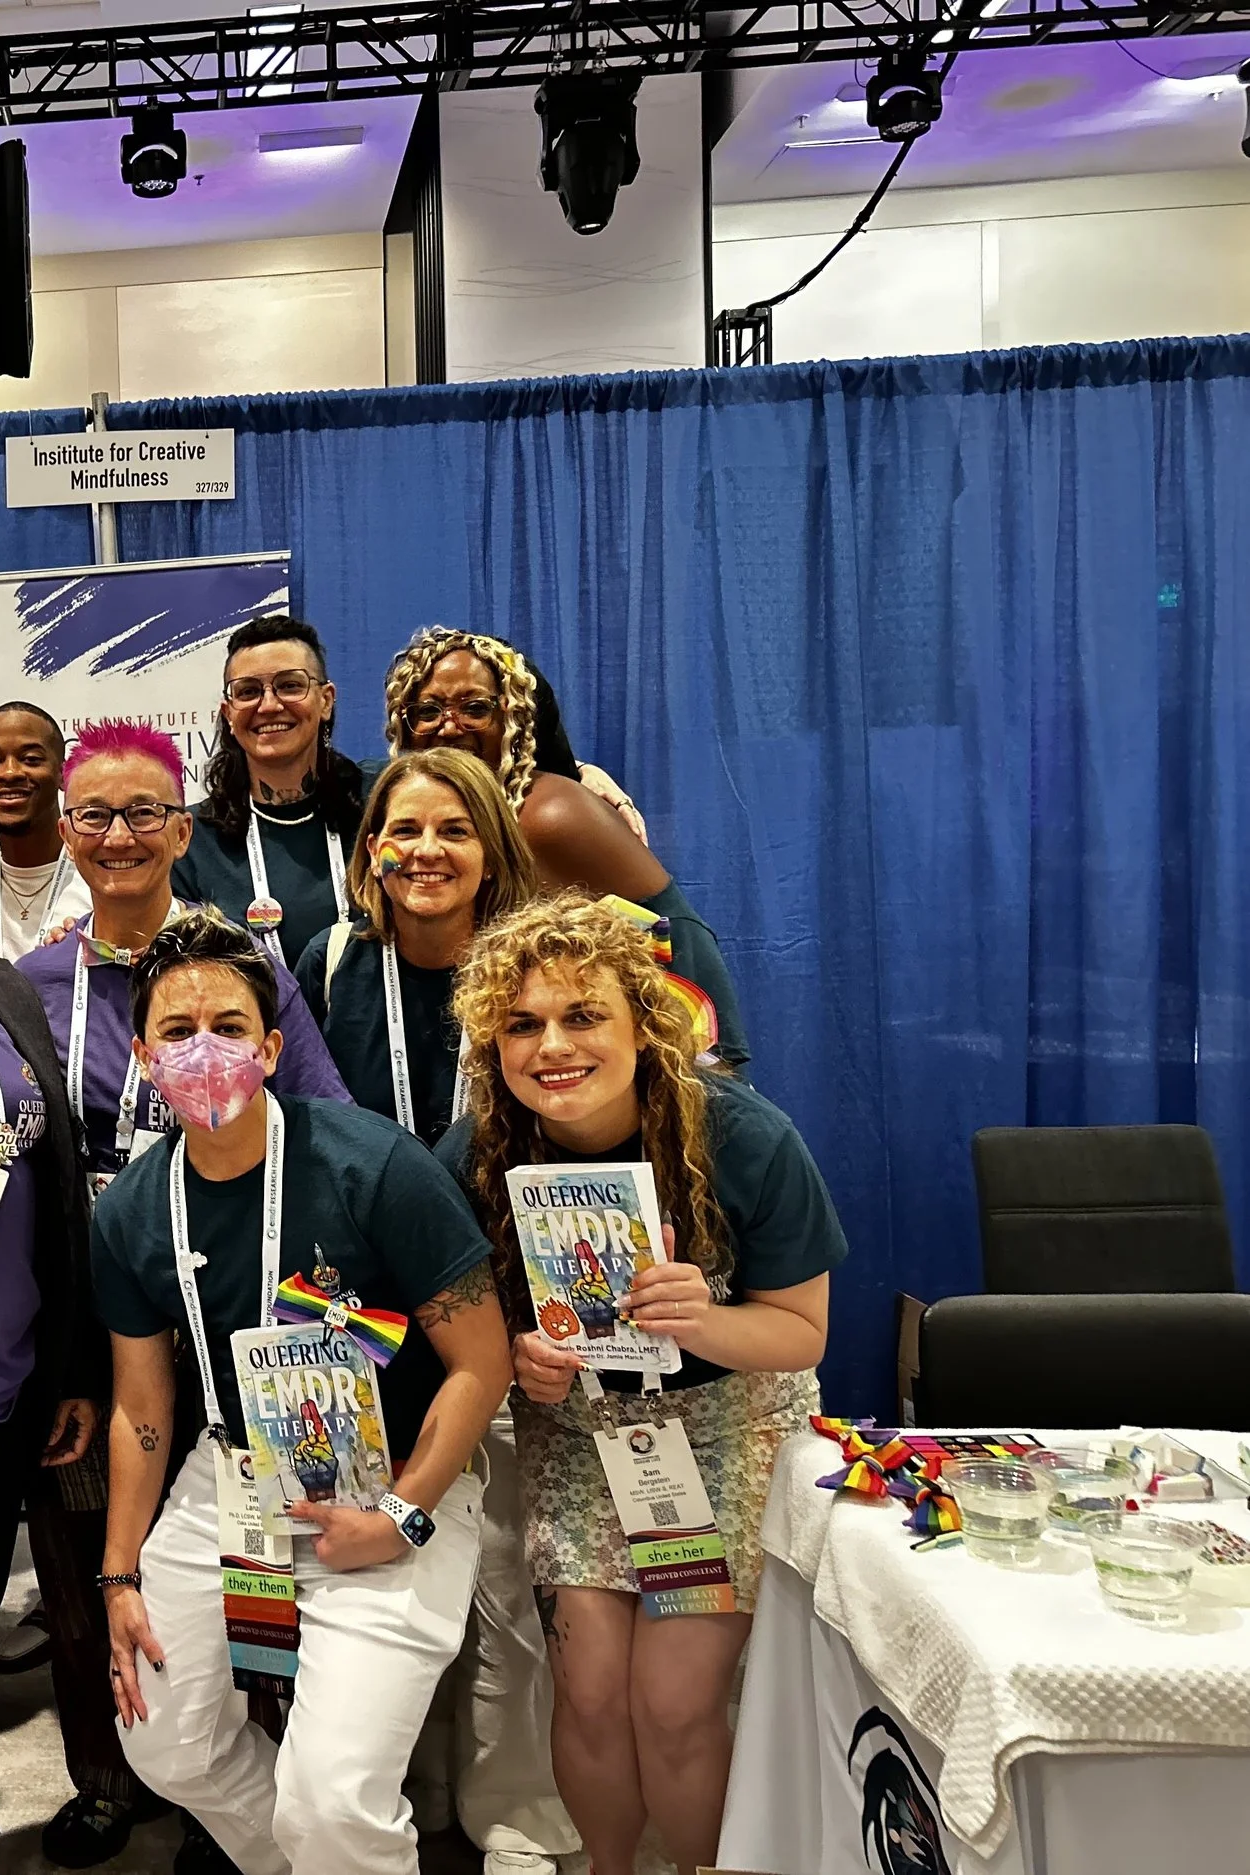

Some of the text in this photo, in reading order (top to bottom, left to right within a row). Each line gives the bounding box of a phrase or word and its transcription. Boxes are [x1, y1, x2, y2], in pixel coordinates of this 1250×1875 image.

[33, 441, 206, 467] Insititute for Creative
[70, 468, 169, 490] Mindfulness
[195, 481, 229, 494] 327/329
[15, 1113, 47, 1139] EMD
[522, 1183, 621, 1208] QUEERING
[526, 1208, 639, 1257] EMDR
[539, 1256, 638, 1275] THERAPY
[327, 1309, 346, 1323] EMDR
[249, 1340, 349, 1370] QUEERING
[606, 1345, 637, 1354] Chabra,
[638, 1346, 660, 1355] LMFT
[252, 1367, 363, 1420] EMDR
[262, 1415, 361, 1439] THERAPY
[643, 1469, 661, 1477] Sam
[648, 1546, 705, 1563] she her
[228, 1578, 288, 1595] they them
